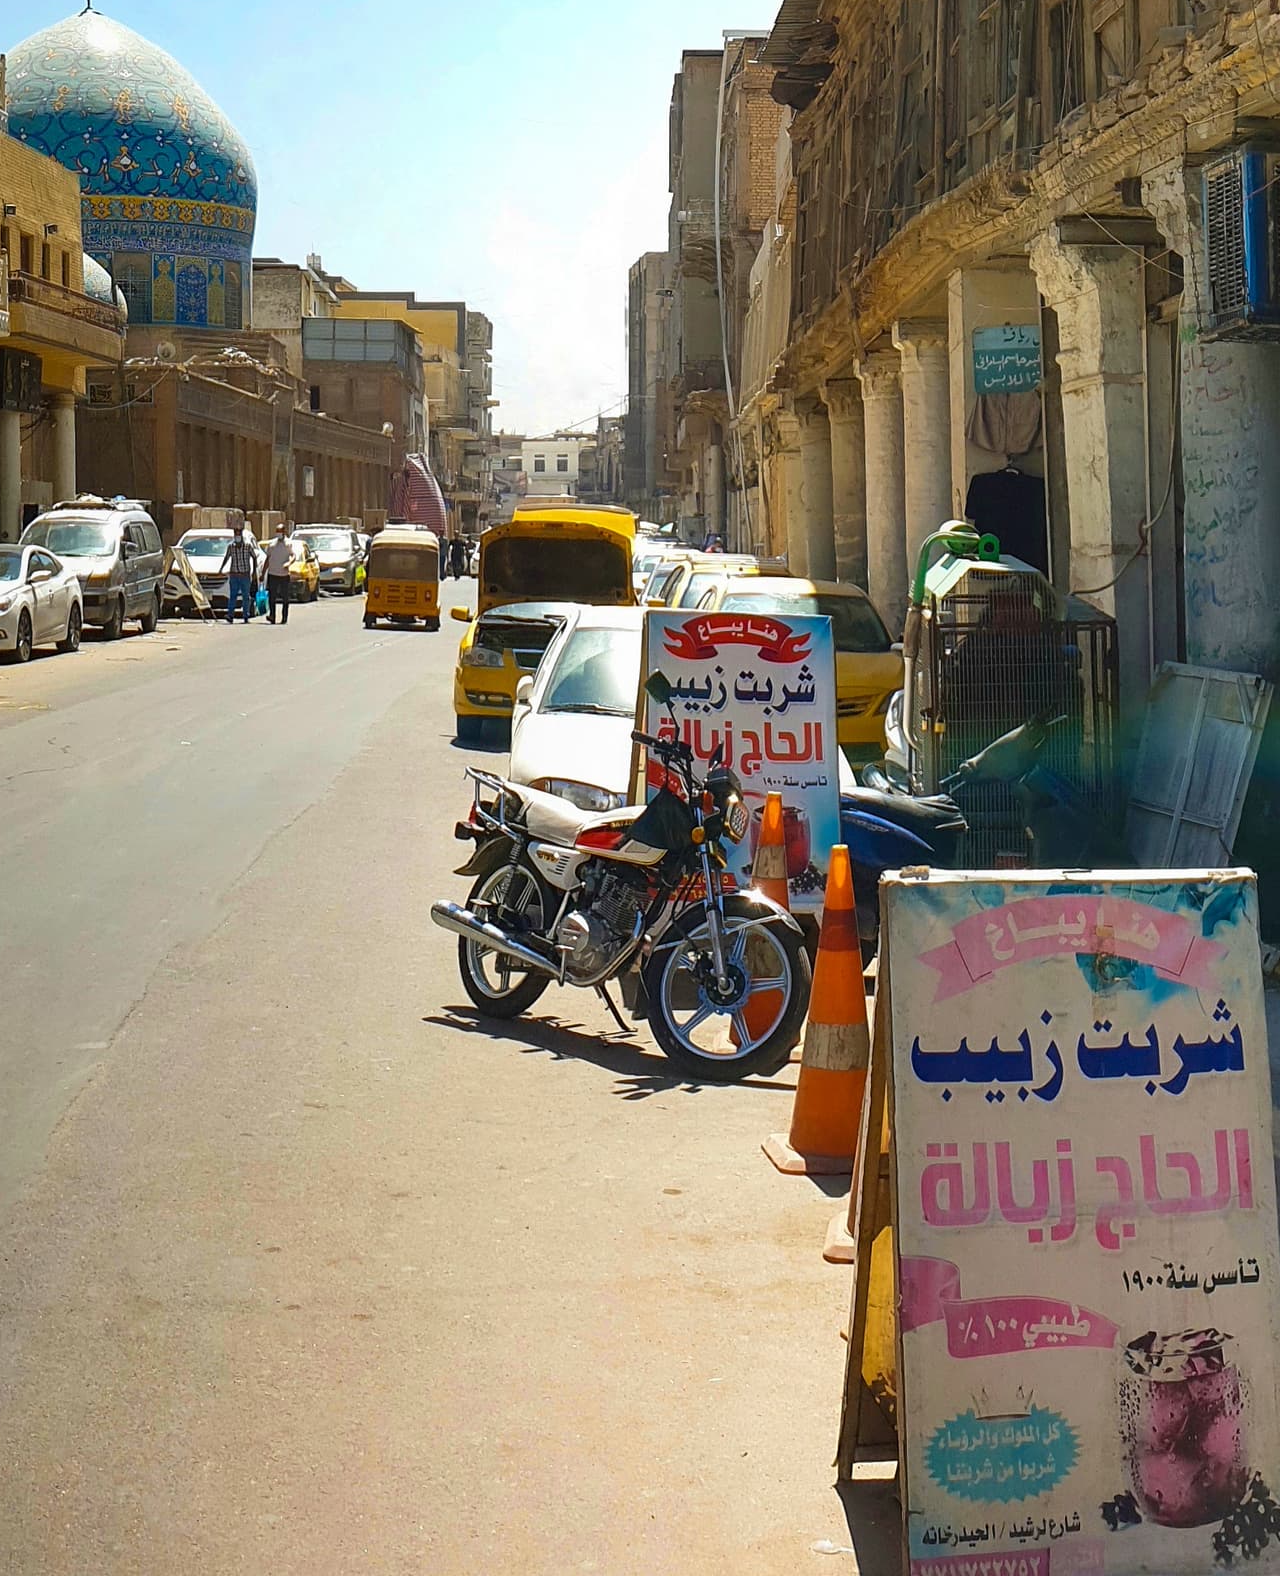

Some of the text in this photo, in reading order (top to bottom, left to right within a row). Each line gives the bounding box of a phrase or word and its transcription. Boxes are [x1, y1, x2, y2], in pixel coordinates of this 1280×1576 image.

[697, 618, 780, 642] هنا يباع
[734, 664, 816, 716] شربت
[739, 721, 825, 776] الحاج
[910, 998, 1247, 1104] شربت زبيب
[920, 1128, 1254, 1251] الحاج زبالة
[1122, 1257, 1261, 1294] تأسس سنة ١٩٠٠
[1022, 1304, 1091, 1350] طبيعي
[1042, 1422, 1061, 1445] كل
[997, 1464, 1014, 1483] من
[1018, 1452, 1057, 1481] شربوا
[1049, 1511, 1082, 1539] شارع
